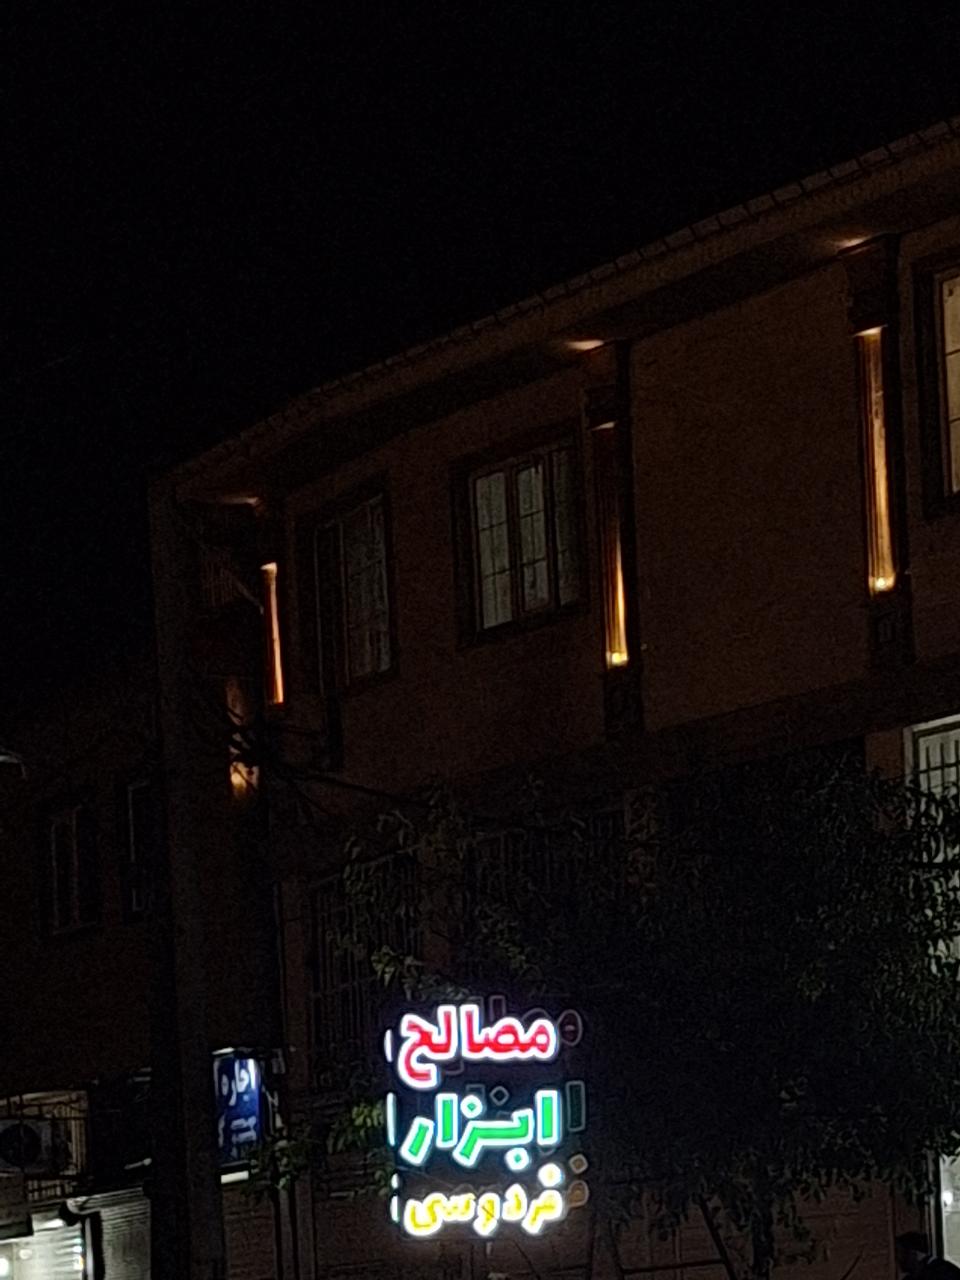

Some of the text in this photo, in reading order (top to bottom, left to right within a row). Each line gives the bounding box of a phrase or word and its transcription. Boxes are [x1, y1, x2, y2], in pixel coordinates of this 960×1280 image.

[398, 1004, 556, 1088] مصالح
[401, 1090, 560, 1171] ابزار
[404, 1163, 563, 1236] فردوسی
